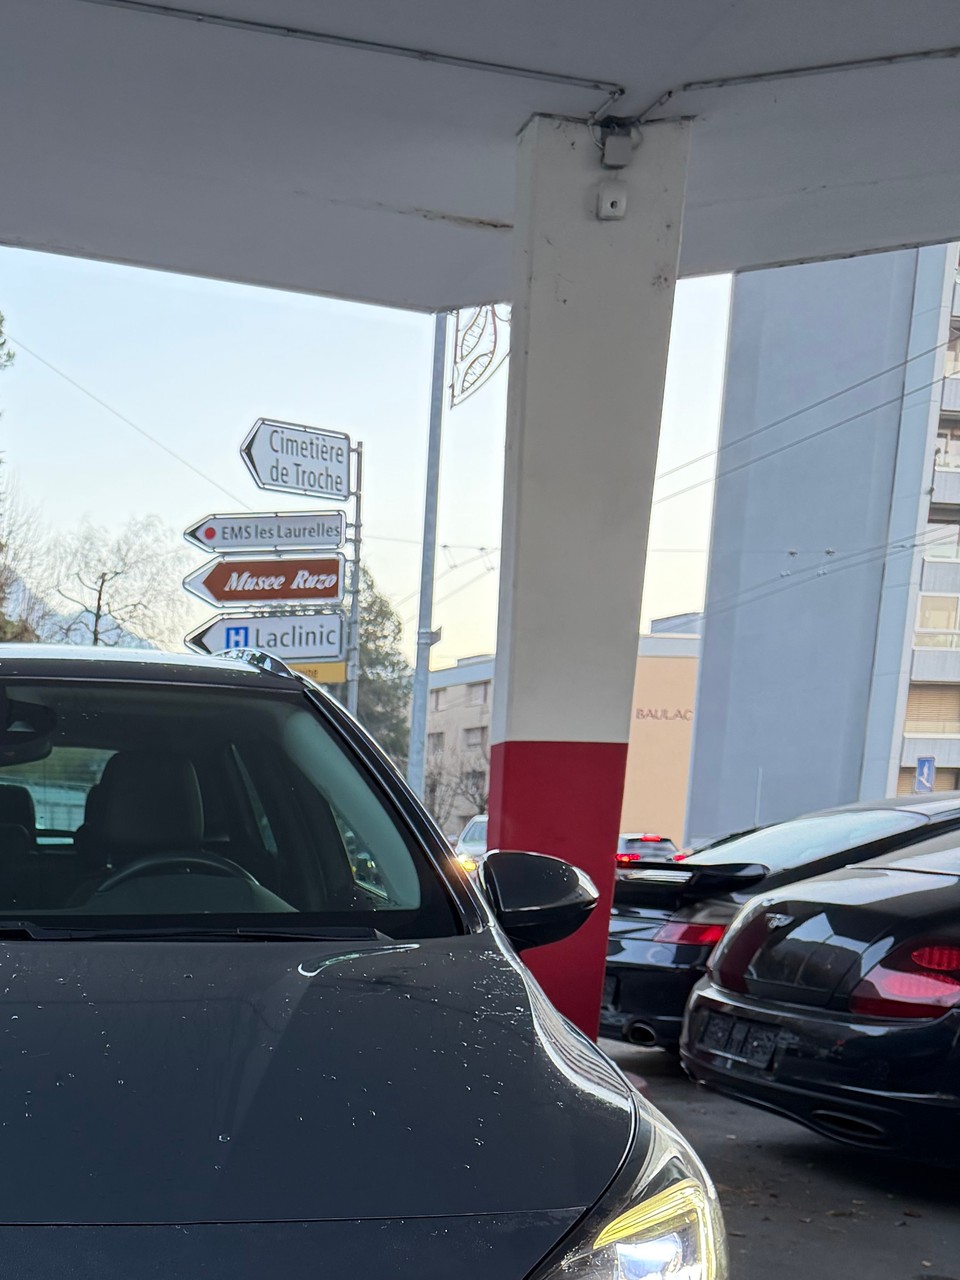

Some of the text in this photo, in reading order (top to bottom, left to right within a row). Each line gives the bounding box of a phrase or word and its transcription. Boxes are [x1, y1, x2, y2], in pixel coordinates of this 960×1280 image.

[269, 429, 344, 464] Cimetière
[270, 458, 343, 492] de Troche
[221, 522, 340, 540] EMS les Laurelles
[290, 569, 337, 590] Ruzo
[256, 624, 336, 648] Laclinic
